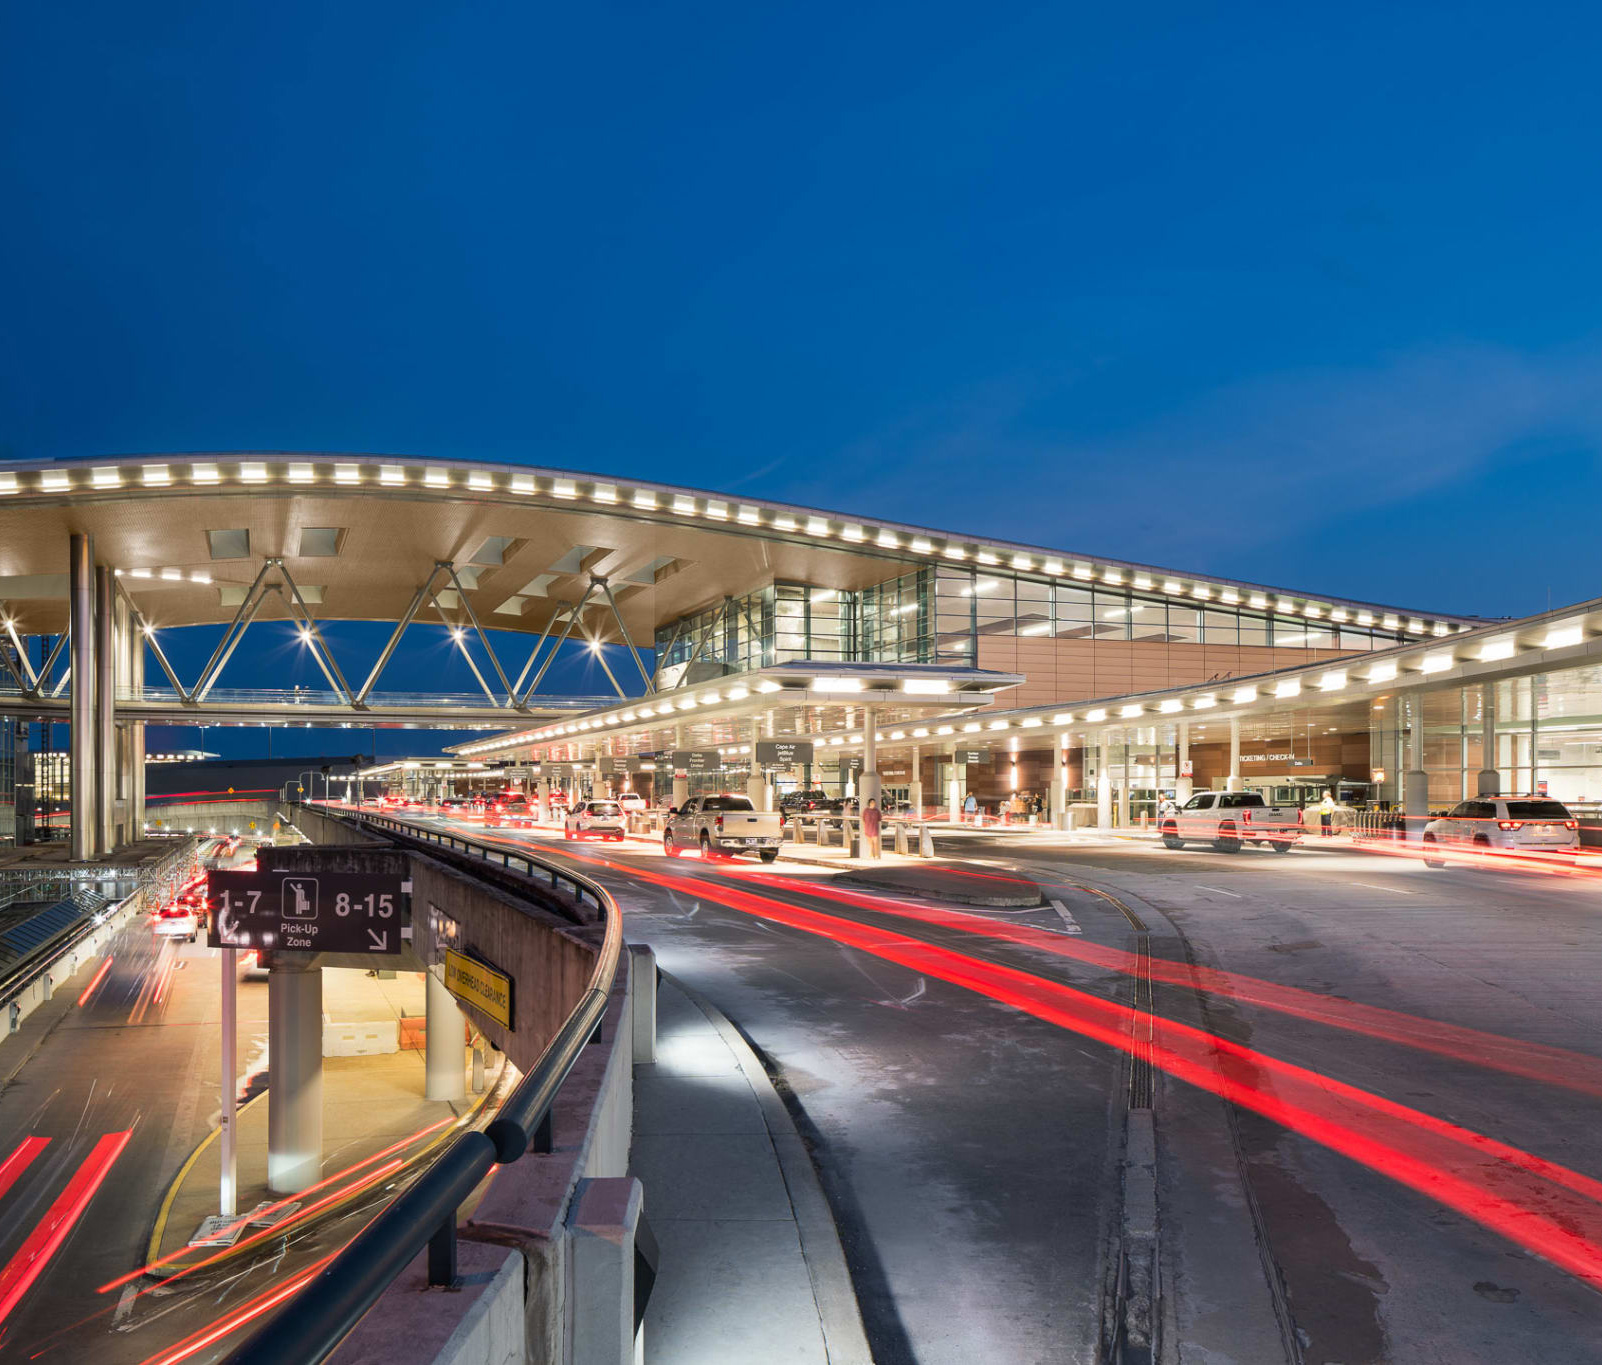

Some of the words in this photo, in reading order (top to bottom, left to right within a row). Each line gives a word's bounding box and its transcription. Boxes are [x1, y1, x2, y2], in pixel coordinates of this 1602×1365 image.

[1269, 753, 1295, 761] CHECK-IN
[219, 889, 262, 913] 1-7
[335, 893, 393, 918] 8-15
[280, 923, 319, 936] Pick-Up
[287, 937, 311, 948] Zone
[457, 967, 479, 992] OVERHEAD
[480, 981, 506, 1009] CLEARANCE
